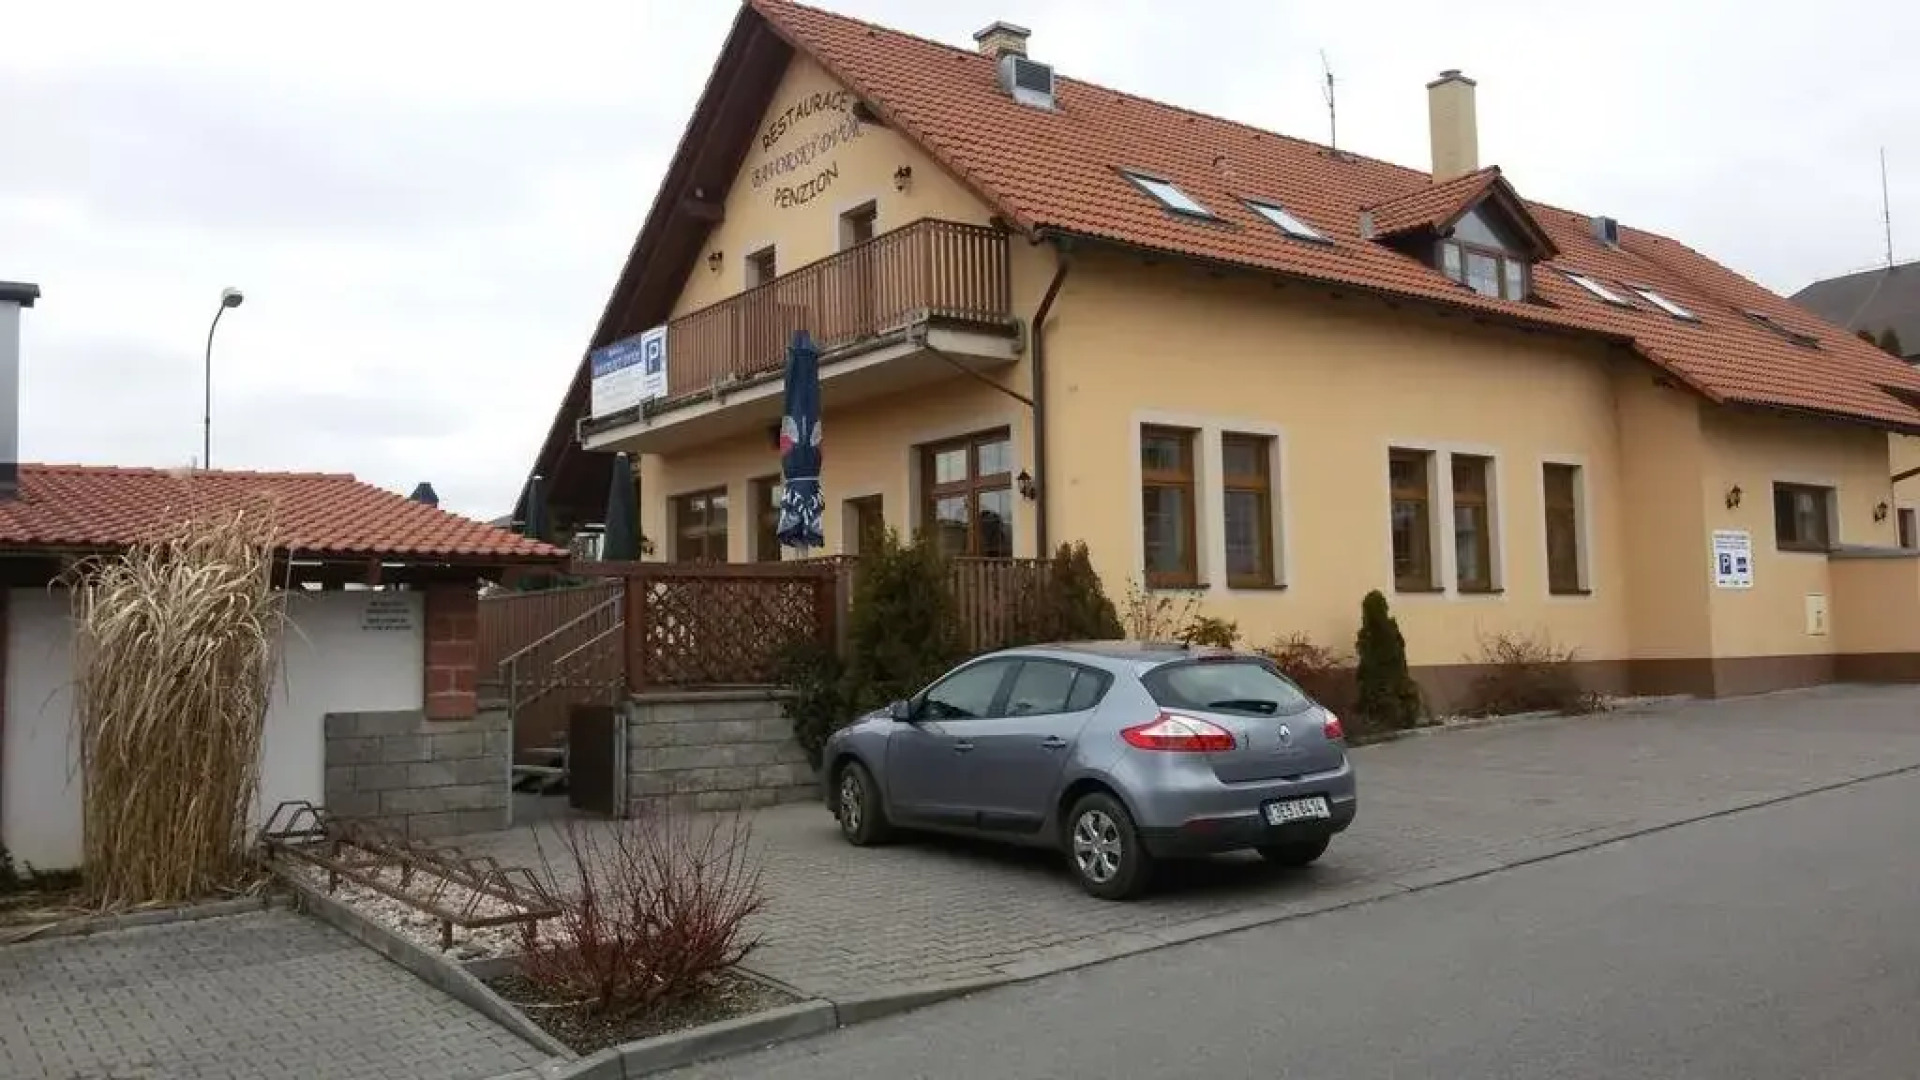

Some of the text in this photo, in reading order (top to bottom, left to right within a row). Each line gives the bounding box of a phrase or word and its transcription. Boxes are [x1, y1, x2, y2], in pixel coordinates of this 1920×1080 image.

[762, 91, 849, 152] RESTAURACE
[773, 161, 838, 209] PENZION
[649, 342, 659, 372] P
[1722, 556, 1730, 573] P
